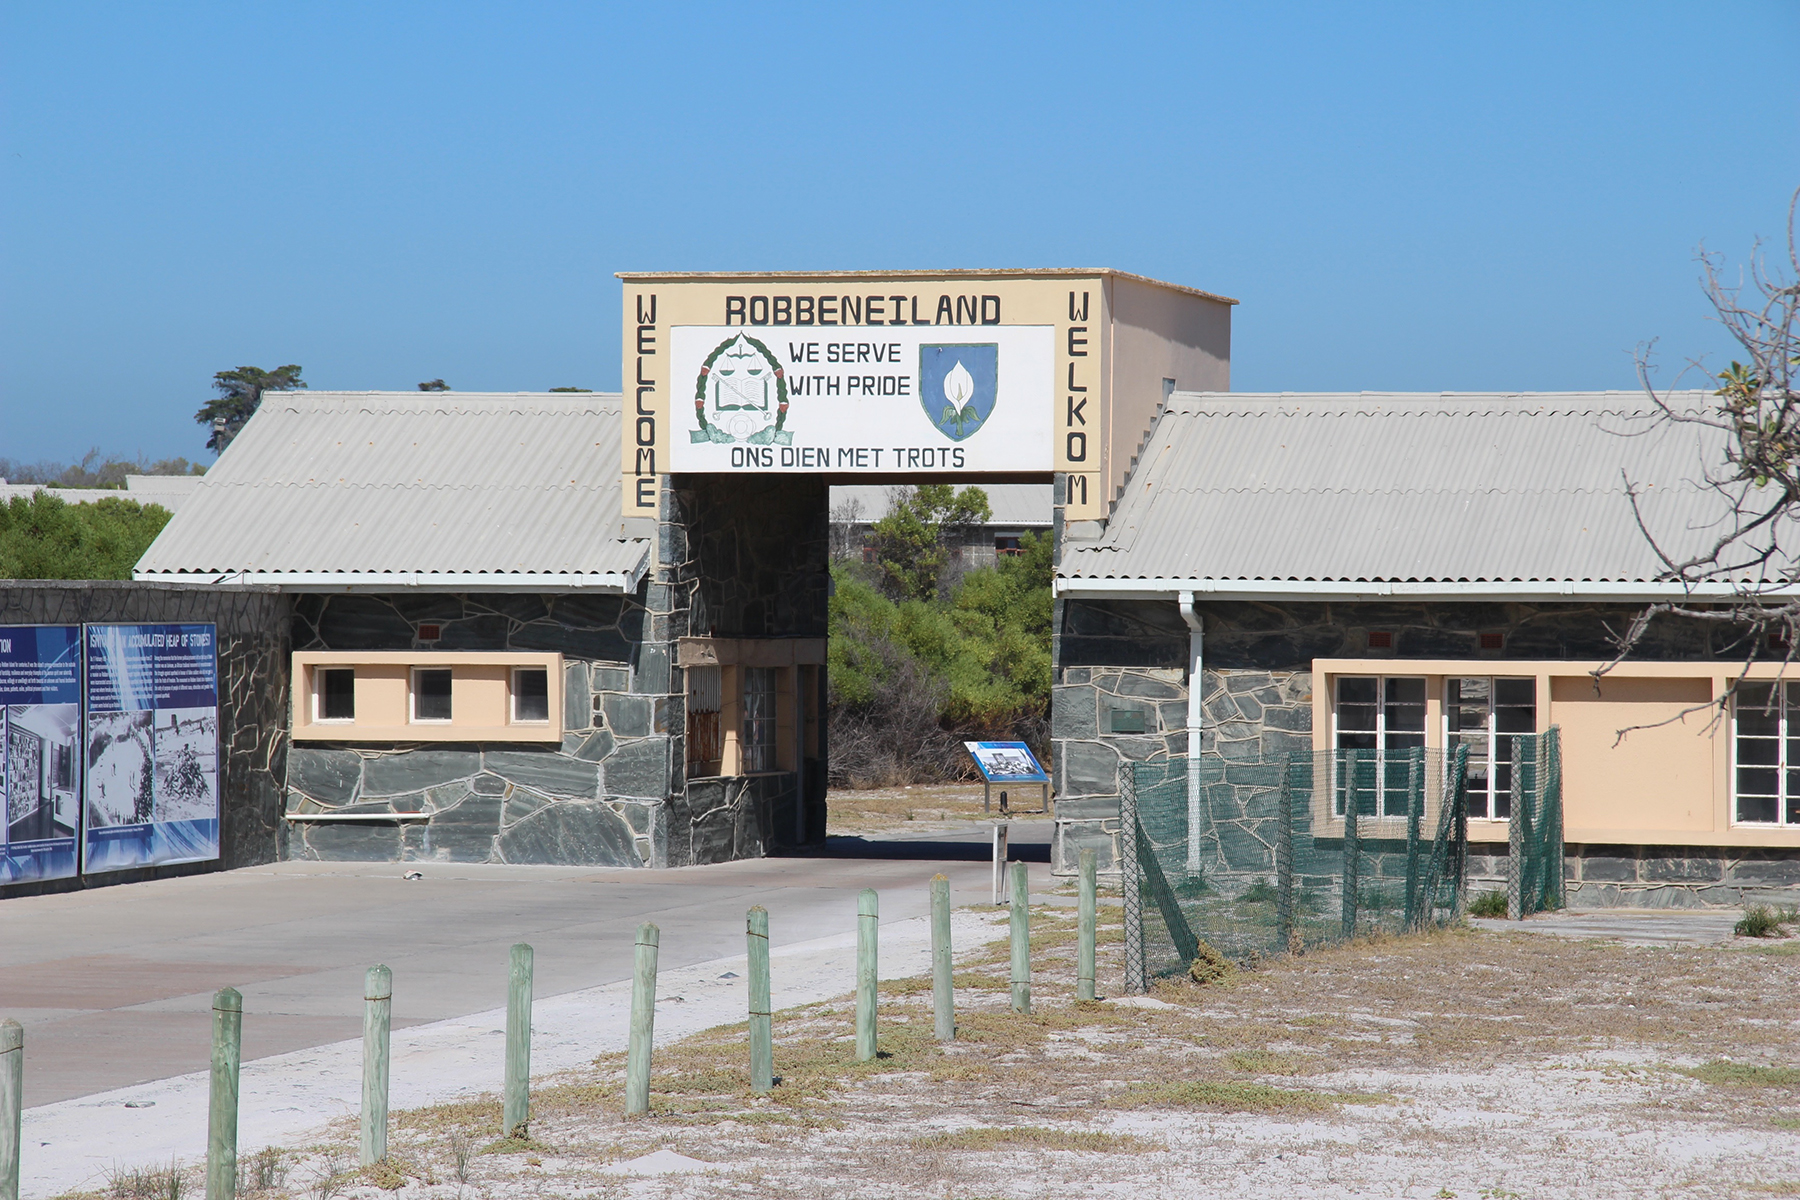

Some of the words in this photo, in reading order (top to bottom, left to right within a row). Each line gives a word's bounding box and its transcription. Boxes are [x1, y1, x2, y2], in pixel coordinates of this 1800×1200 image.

[725, 295, 1001, 326] ROBBENEILAND
[789, 342, 819, 363] WE
[827, 342, 901, 363] SERVE
[789, 375, 840, 396] WITH
[847, 375, 911, 396] PRIDE
[635, 294, 657, 508] WELCOME
[1066, 291, 1089, 506] WELKOM
[731, 447, 773, 468] ONS
[781, 447, 830, 468] DIEN
[838, 447, 884, 468] MET
[892, 447, 965, 468] TROTS
[166, 634, 180, 648] HEAP
[181, 634, 189, 647] OF
